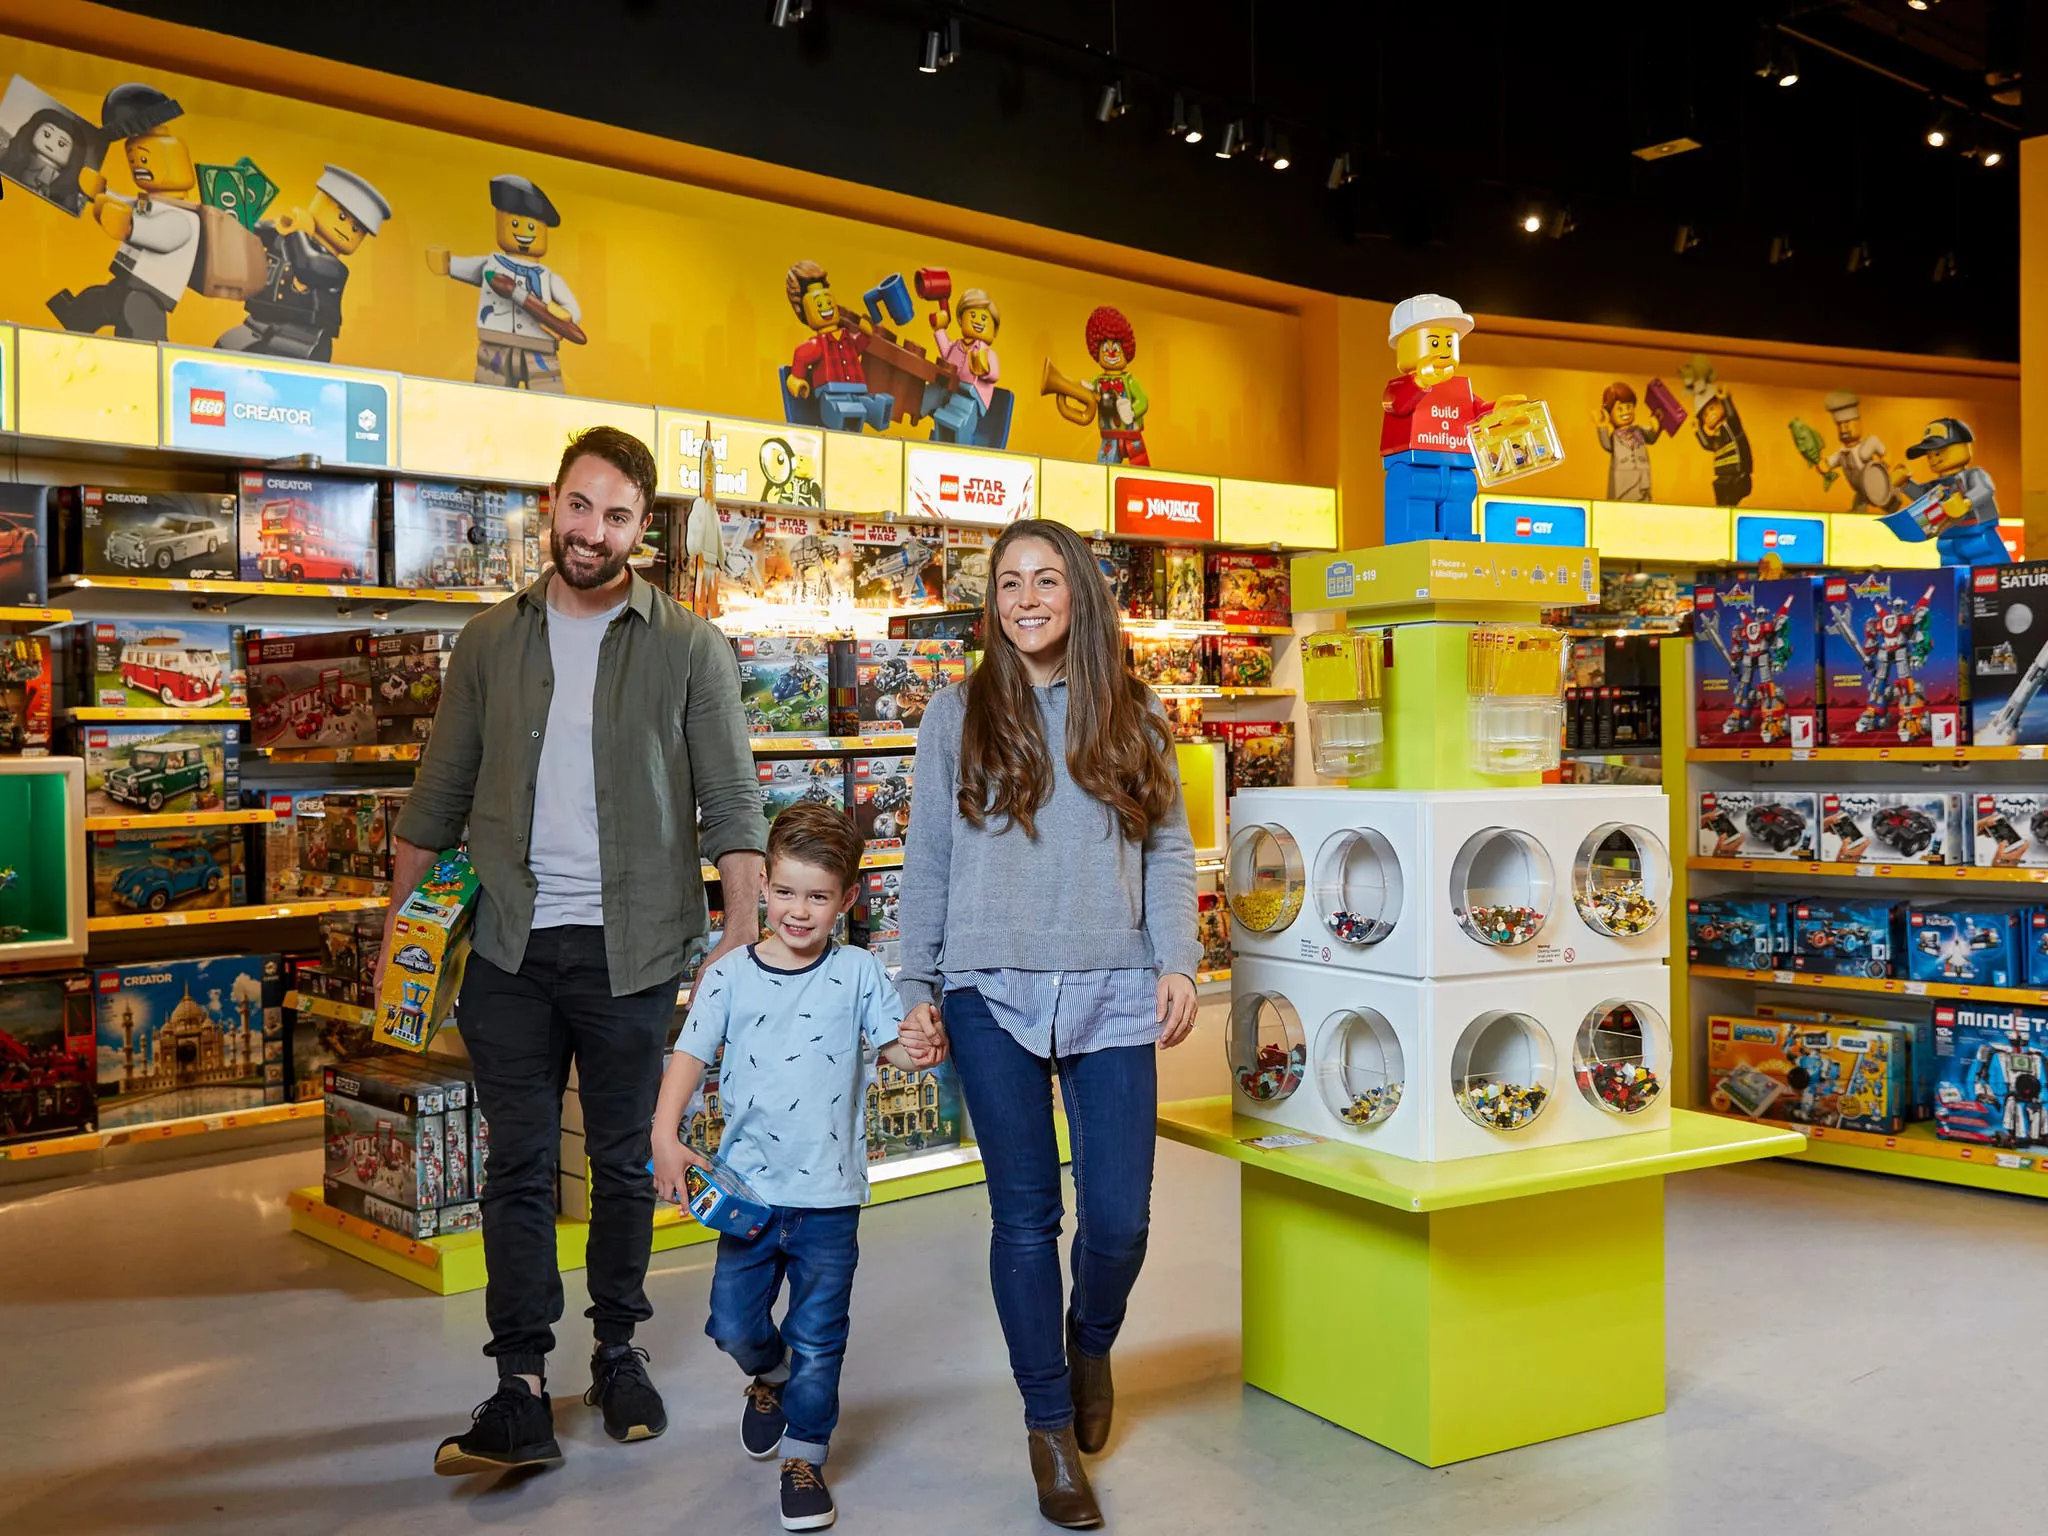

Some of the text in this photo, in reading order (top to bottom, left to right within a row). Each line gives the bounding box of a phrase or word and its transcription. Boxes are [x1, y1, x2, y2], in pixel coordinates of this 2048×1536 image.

[191, 397, 313, 426] LEGO CREATOR
[1431, 405, 1459, 419] Build
[1441, 421, 1449, 430] a
[680, 429, 727, 461] Had
[267, 478, 313, 491] CREATOR
[715, 465, 748, 494] ind
[963, 478, 1006, 493] STAR
[105, 493, 148, 505] CREATOR
[963, 490, 1006, 506] WARS
[1145, 497, 1202, 523] NINJAGO
[868, 526, 897, 534] STAR
[868, 533, 897, 541] WARS
[123, 973, 173, 987] CREATOR
